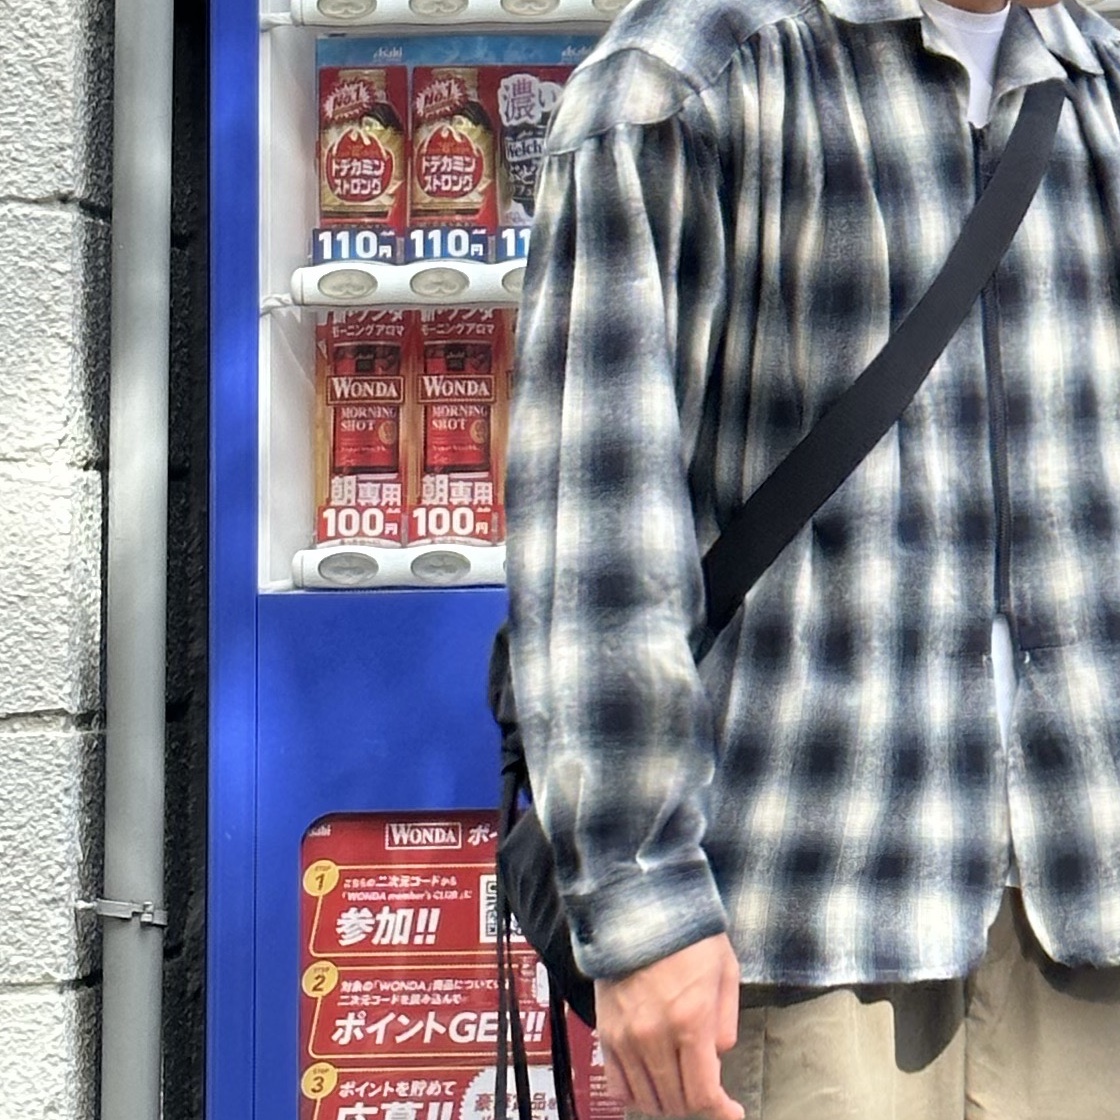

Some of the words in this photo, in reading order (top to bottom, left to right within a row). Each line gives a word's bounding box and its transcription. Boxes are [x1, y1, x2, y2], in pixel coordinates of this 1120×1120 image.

[333, 178, 382, 195] ストロング
[423, 174, 474, 192] ストロング
[331, 377, 399, 399] WONDA
[422, 375, 490, 398] WONDA
[340, 405, 397, 418] MORNING
[431, 404, 488, 417] MORNING
[340, 419, 376, 432] SHOT
[431, 418, 467, 431] SHOT
[331, 475, 401, 506] 朝専用
[422, 474, 493, 505] 朝専用
[390, 823, 457, 845] WONDA
[315, 873, 325, 891] 1
[335, 906, 441, 946] 参加!!
[312, 975, 326, 992] 2
[311, 1076, 325, 1093] 3
[338, 1080, 458, 1097] ポイントを貯めて
